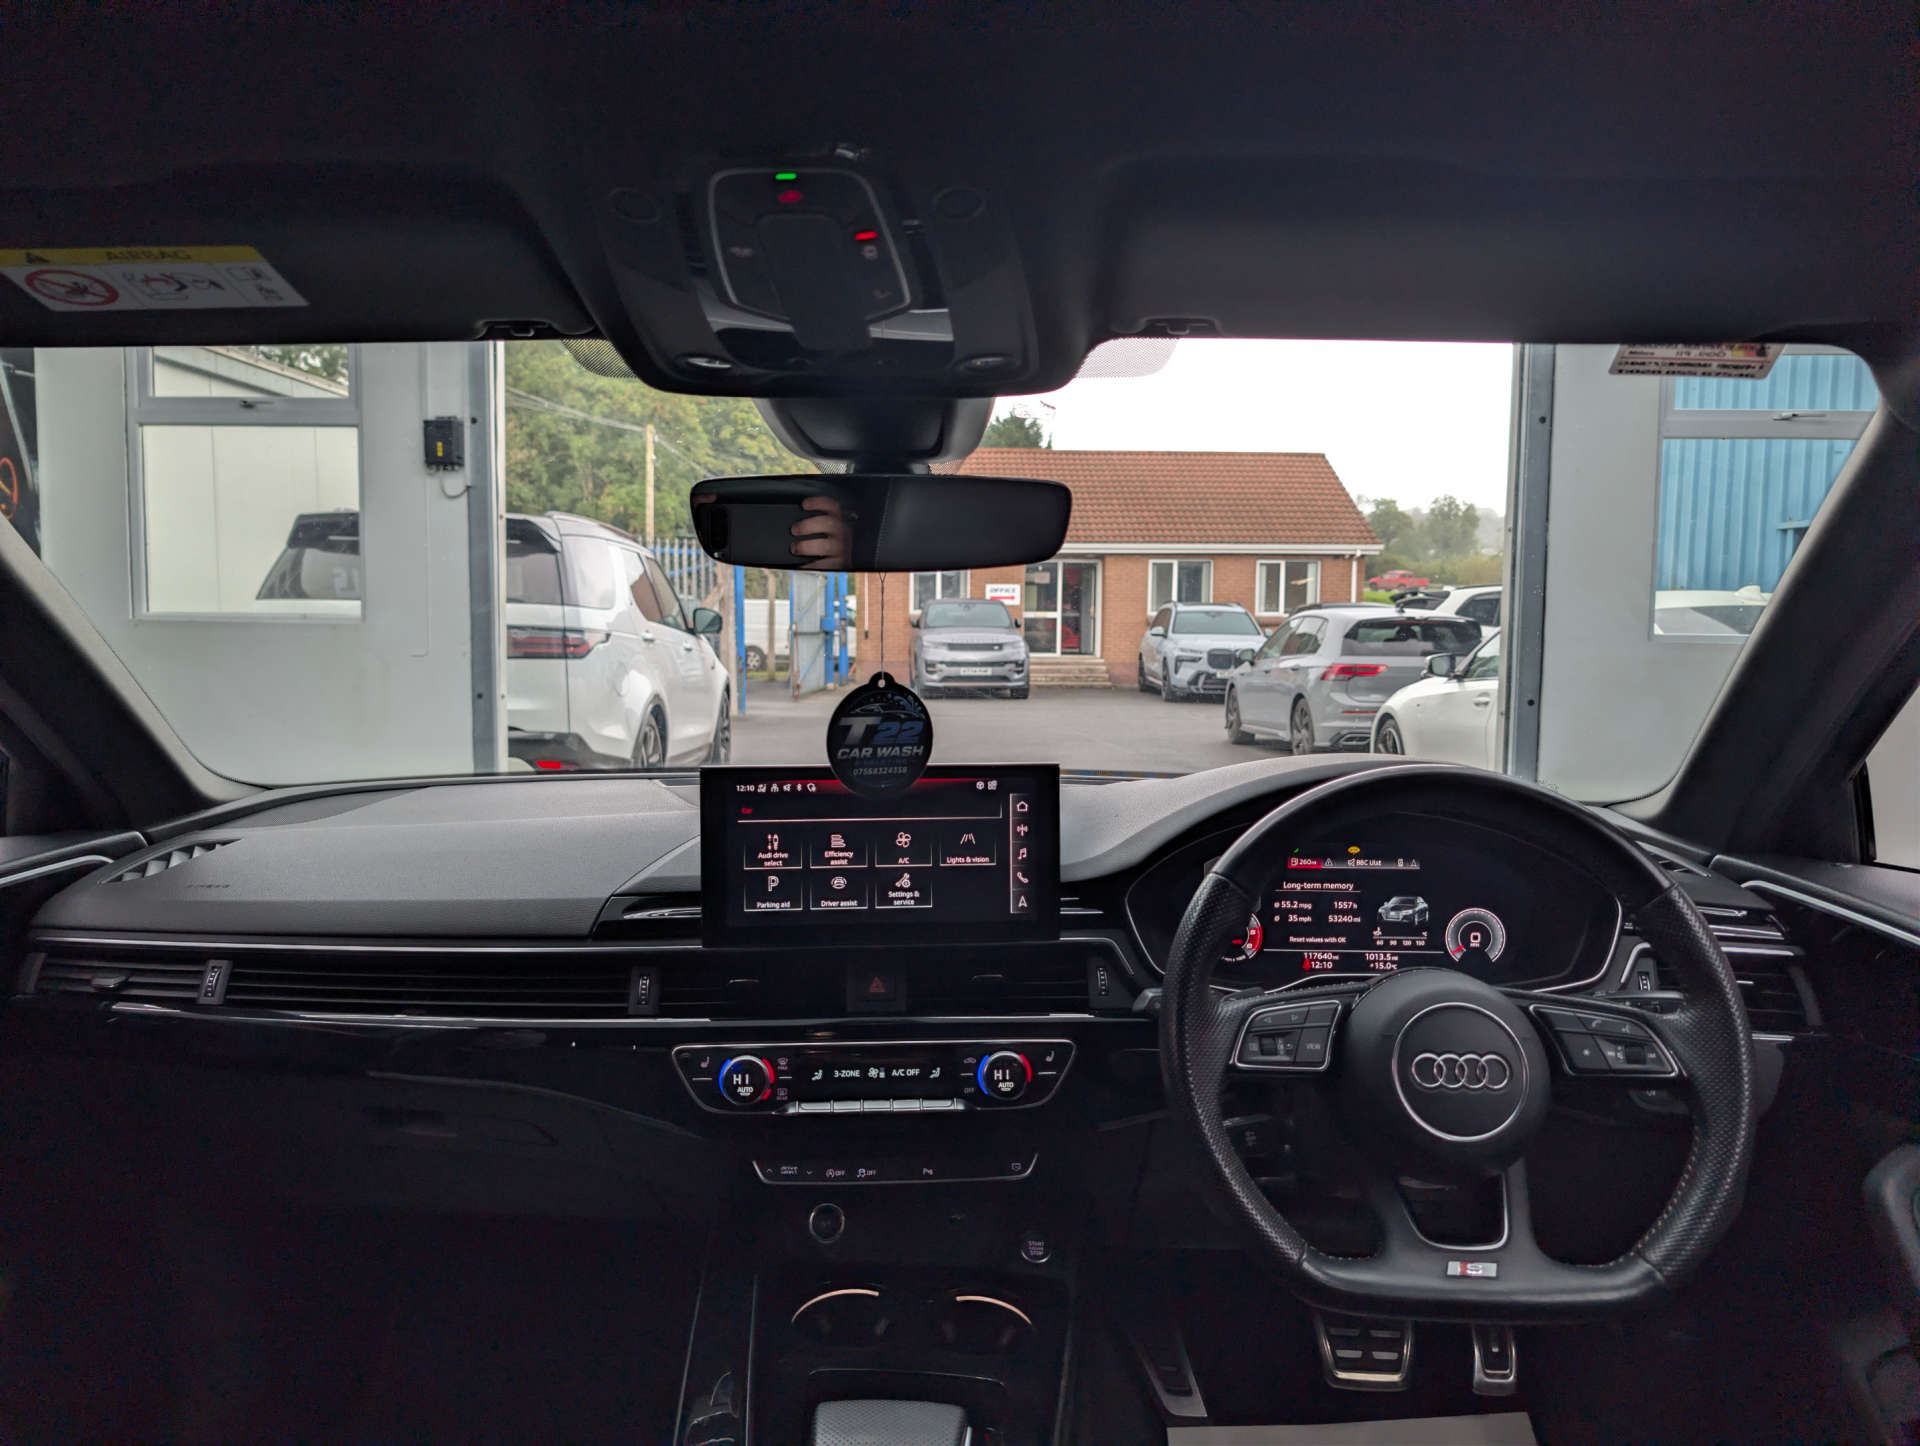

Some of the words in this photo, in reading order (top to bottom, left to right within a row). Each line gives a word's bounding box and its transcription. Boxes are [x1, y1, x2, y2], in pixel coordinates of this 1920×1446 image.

[837, 747, 873, 760] CAR
[876, 745, 924, 758] WASH
[736, 783, 755, 792] 12:10
[757, 851, 772, 859] Audi
[773, 851, 789, 859] drive
[824, 850, 854, 860] Efficiency
[764, 859, 783, 867] select
[946, 856, 964, 865] Lights
[972, 855, 989, 863] vision
[1283, 881, 1322, 890] Long-term
[1323, 882, 1354, 891] memory
[888, 890, 913, 900] Settings
[756, 901, 780, 910] Parking
[893, 898, 915, 906] service
[1281, 901, 1298, 909] 55.2
[1311, 961, 1333, 969] 12:10
[833, 1069, 861, 1079] 3-ZONE
[891, 1068, 905, 1078] A/C
[906, 1068, 920, 1077] OFF
